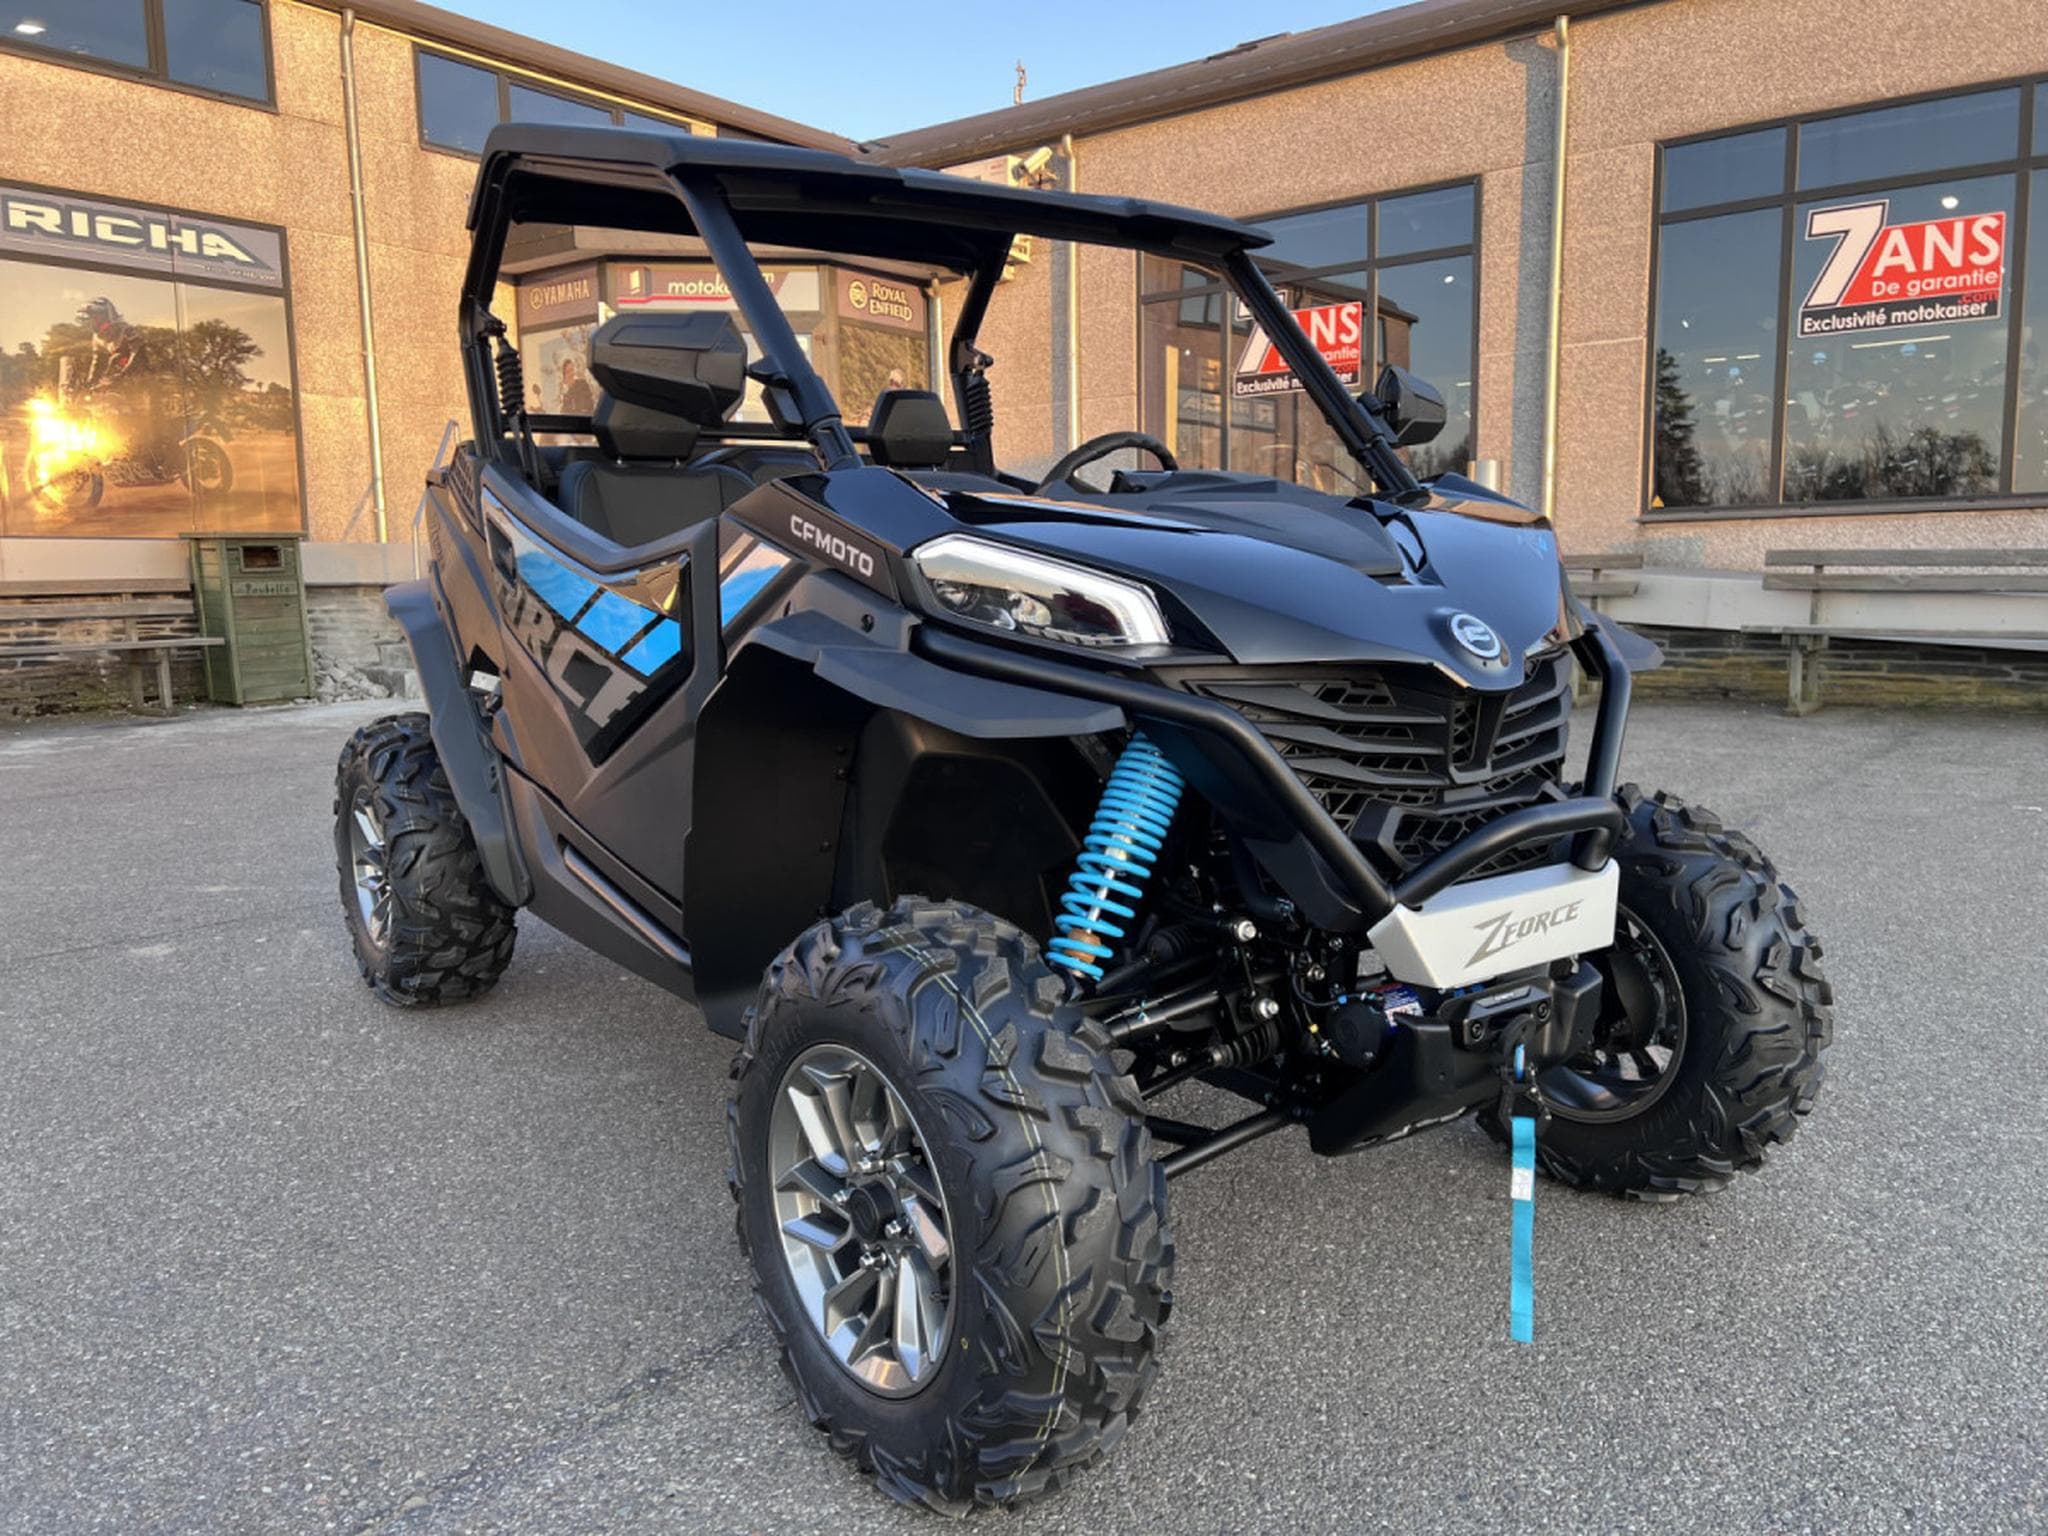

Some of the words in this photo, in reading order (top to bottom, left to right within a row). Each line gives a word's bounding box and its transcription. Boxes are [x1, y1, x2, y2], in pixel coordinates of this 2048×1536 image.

[8, 201, 255, 264] RICHA
[1806, 201, 1888, 309] 7
[1872, 216, 2000, 277] ANS
[543, 279, 590, 306] YAMAHA
[872, 282, 908, 305] ROYAL
[1872, 281, 1900, 297] De
[1907, 268, 1998, 296] garantie
[869, 299, 913, 321] ENFIELD
[1294, 304, 1359, 346] NS
[1803, 308, 1887, 333] Exclusivité
[1891, 301, 1988, 326] motokaiser
[791, 515, 874, 577] CFMOTO
